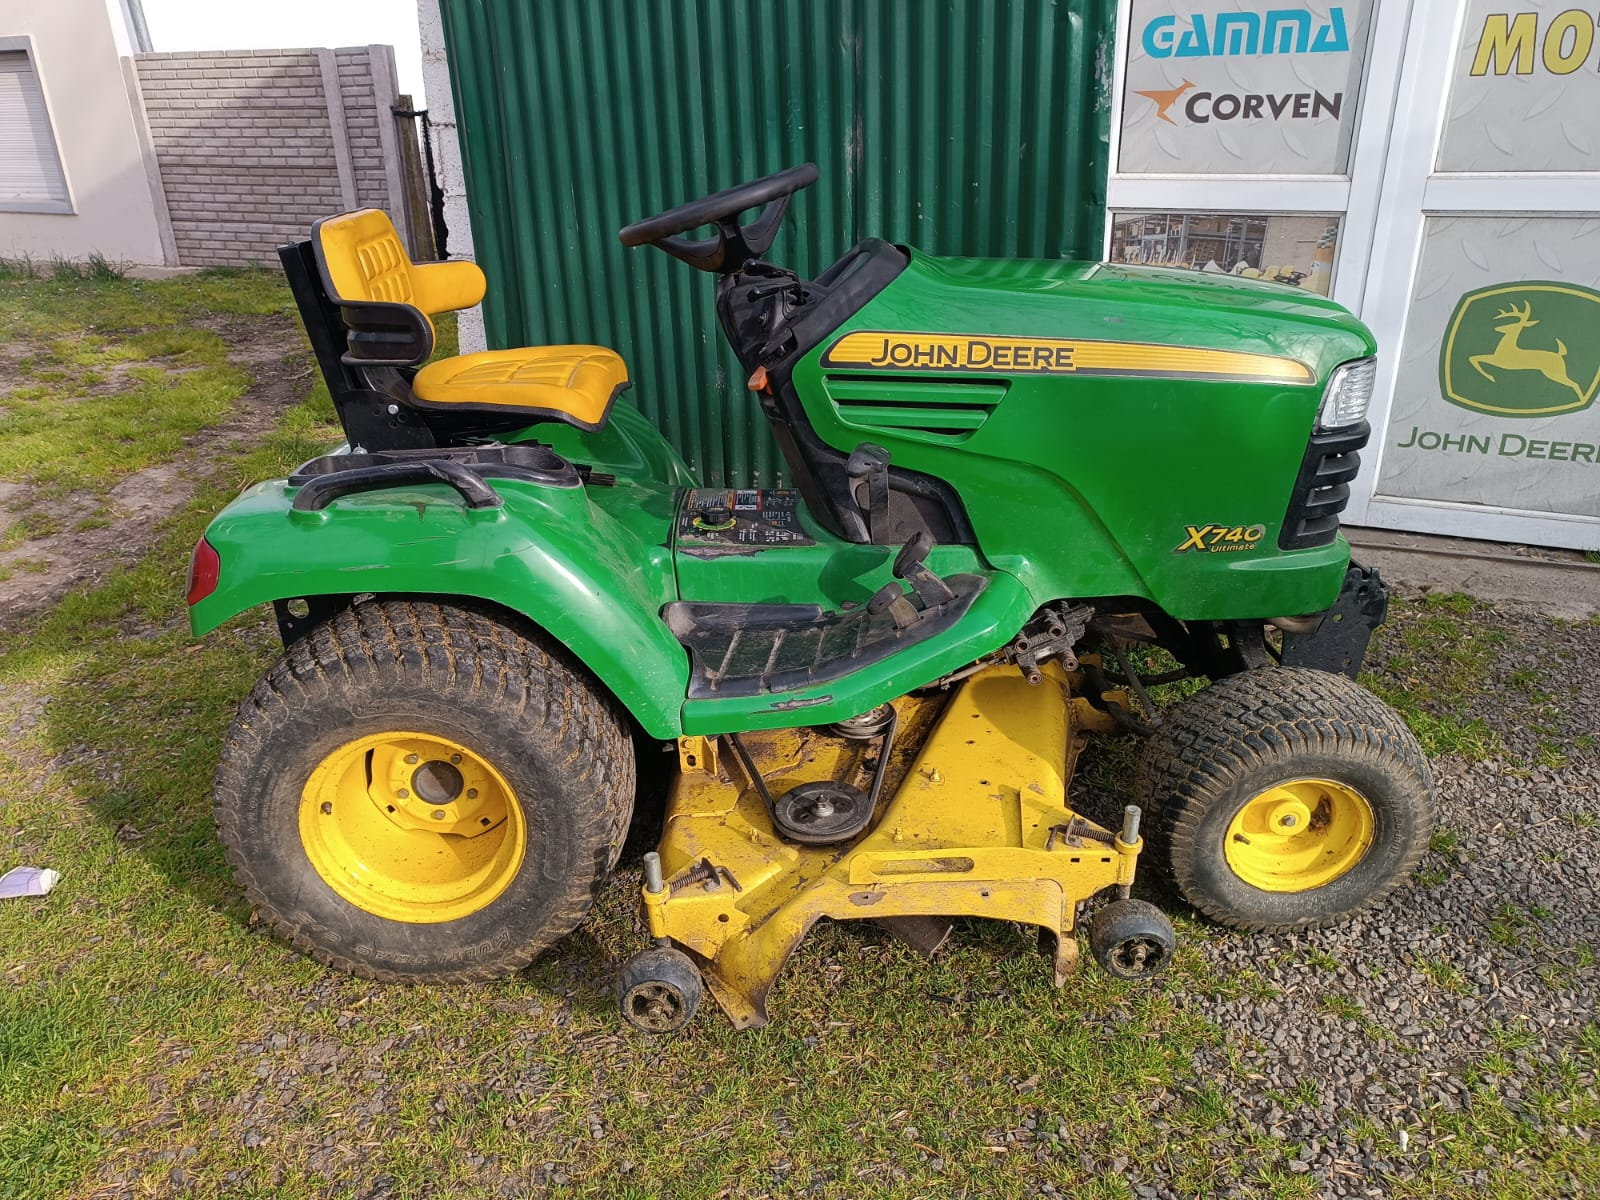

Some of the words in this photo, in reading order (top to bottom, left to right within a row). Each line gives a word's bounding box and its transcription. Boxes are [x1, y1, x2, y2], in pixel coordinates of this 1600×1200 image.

[1141, 8, 1350, 59] GAMMA
[1469, 9, 1600, 76] MO
[1184, 91, 1343, 124] CORVEN
[871, 338, 959, 367] JOHN
[966, 340, 1077, 370] DEERE
[1397, 426, 1491, 455] JOHN
[1498, 433, 1600, 464] DEER
[1175, 525, 1264, 552] X740
[1210, 543, 1256, 553] Ultimate
